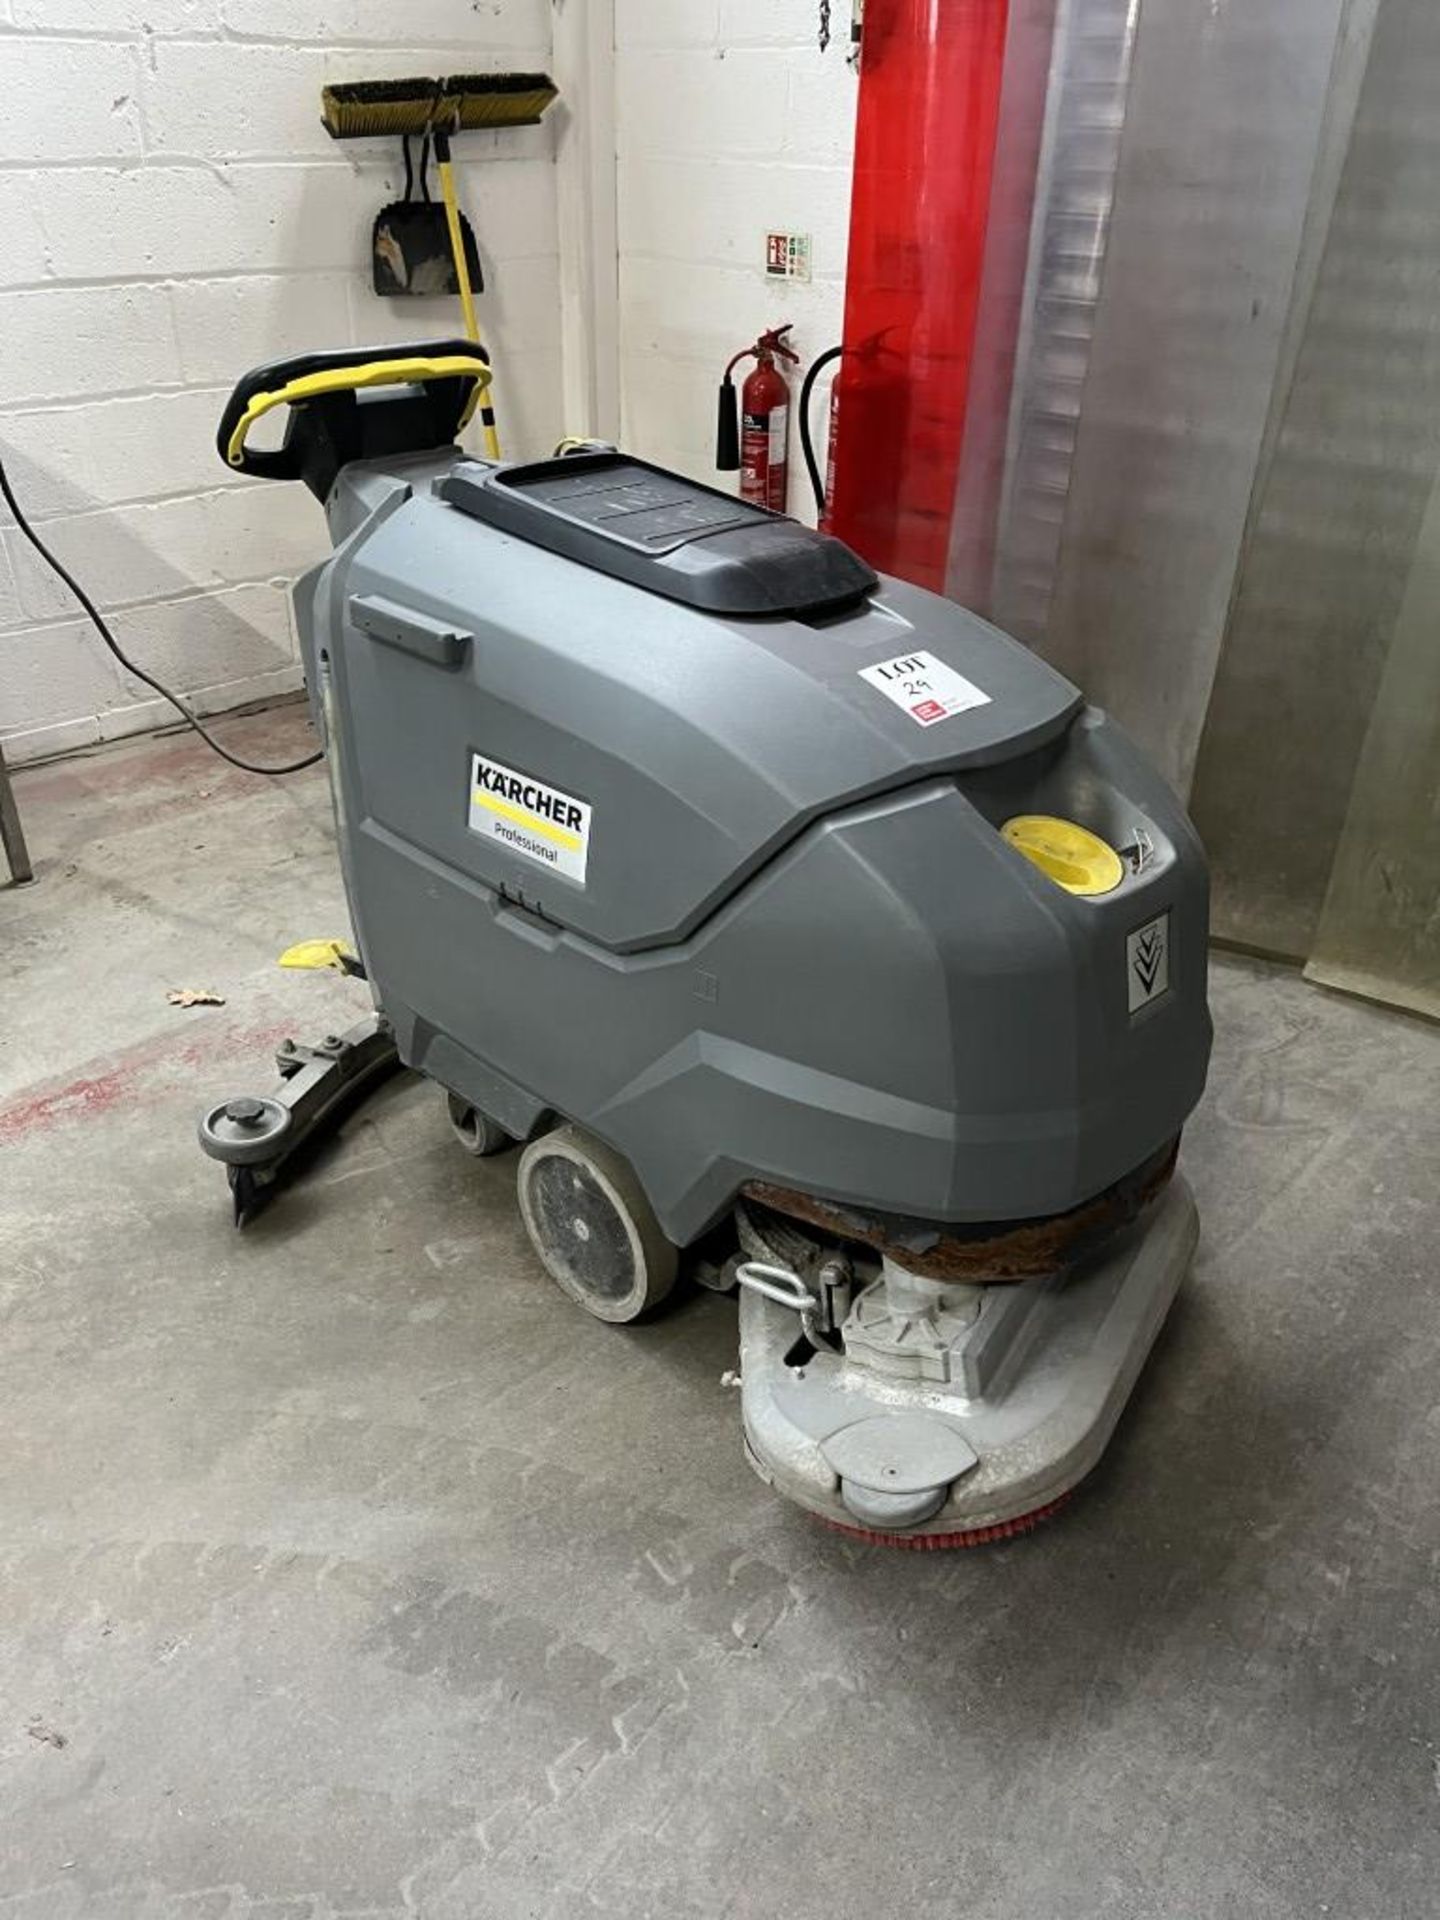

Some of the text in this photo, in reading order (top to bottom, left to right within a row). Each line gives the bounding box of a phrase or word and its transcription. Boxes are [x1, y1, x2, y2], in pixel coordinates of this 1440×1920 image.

[877, 656, 926, 680] LOT
[477, 764, 583, 833] KÄRCHER
[494, 822, 558, 861] Professional
